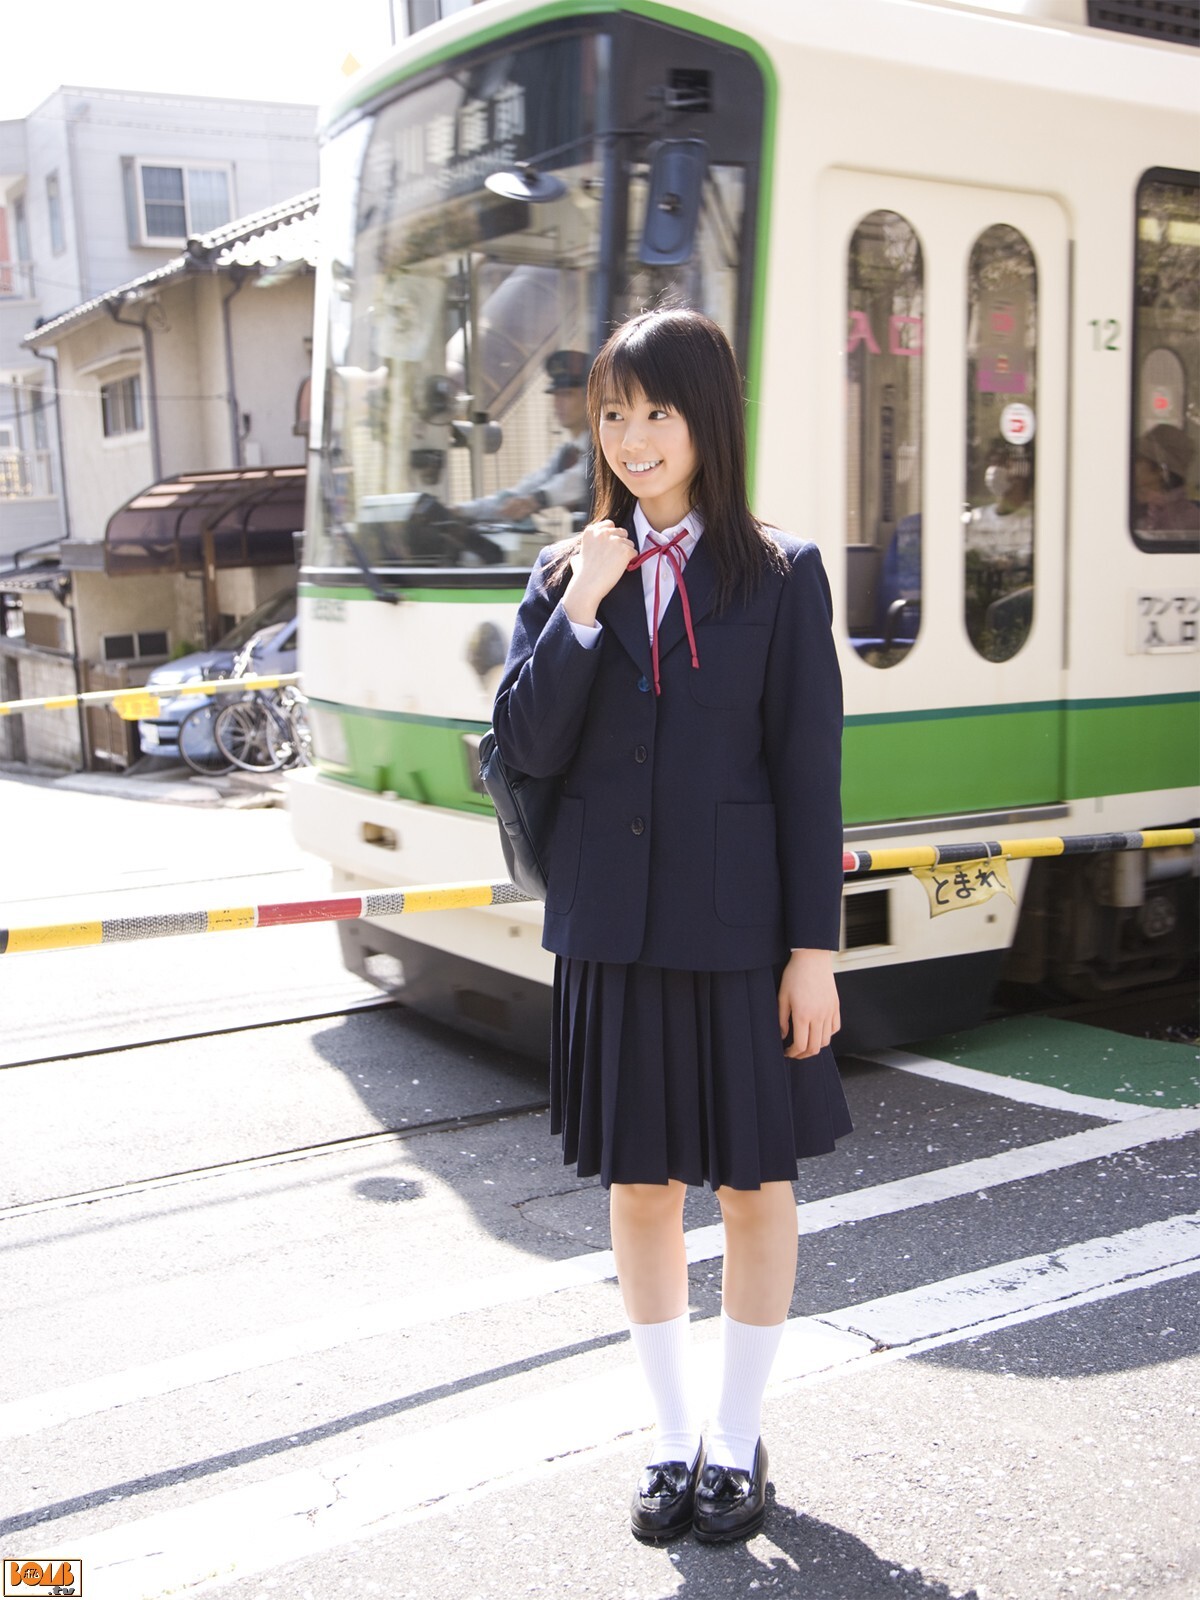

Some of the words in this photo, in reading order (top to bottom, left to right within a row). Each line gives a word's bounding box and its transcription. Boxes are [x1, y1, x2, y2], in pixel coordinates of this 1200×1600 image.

[847, 310, 924, 355] 入口
[1087, 318, 1121, 351] 12
[1143, 620, 1198, 643] 入口
[932, 867, 1006, 905] とまれ
